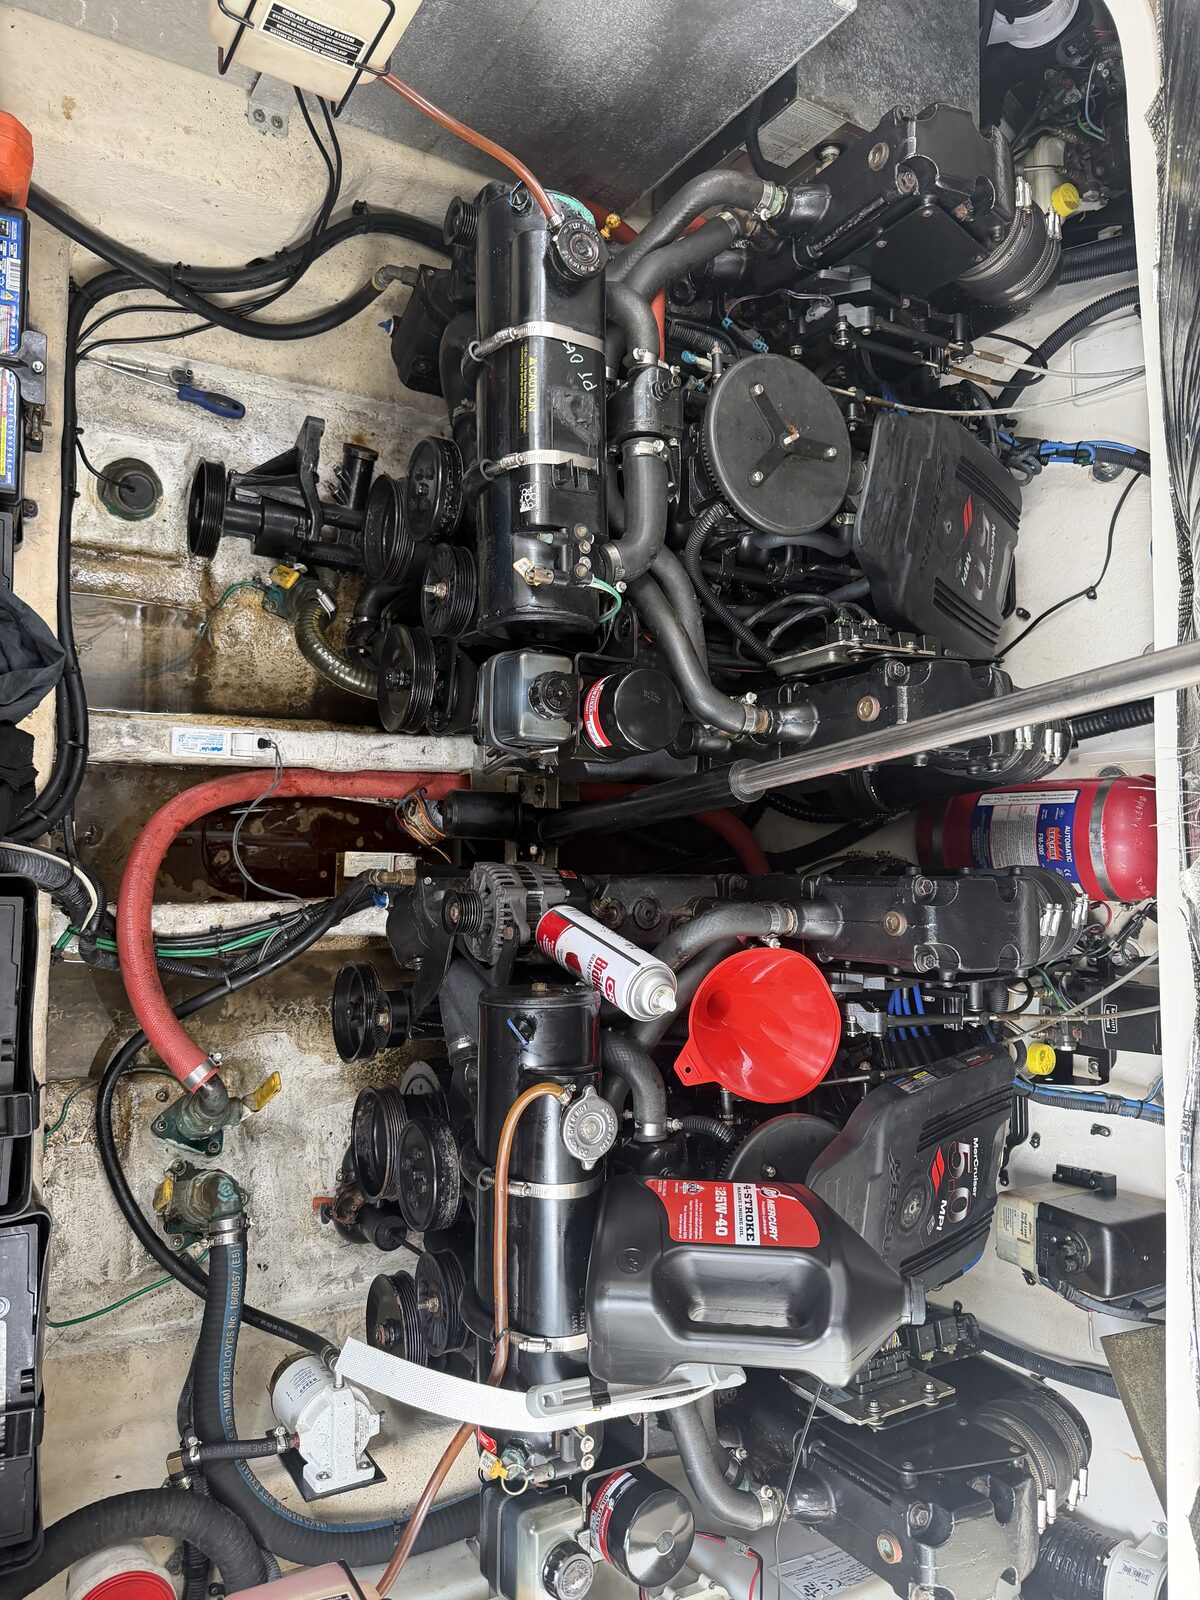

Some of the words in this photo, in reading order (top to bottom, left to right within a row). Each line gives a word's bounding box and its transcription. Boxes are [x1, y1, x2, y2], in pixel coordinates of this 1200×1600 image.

[281, 9, 307, 24] COOLANT
[306, 20, 335, 35] RECOVERY
[334, 32, 355, 44] SYSTEM
[529, 367, 537, 412] CAUTION
[960, 551, 972, 588] MPI
[987, 523, 995, 589] MerCruiser
[1064, 826, 1072, 862] AUTOMATIC
[587, 953, 596, 969] BRAKE
[947, 1141, 972, 1223] 5.0
[715, 1190, 728, 1236] 25W-40
[744, 1185, 755, 1241] 4-STROKE
[766, 1199, 778, 1242] MERCURY
[936, 1200, 948, 1231] MPI
[230, 1249, 241, 1267] (E5)
[228, 1271, 241, 1309] 16/80057
[226, 1313, 237, 1328] No.
[221, 1331, 235, 1369] LLOYDS
[221, 1371, 231, 1387] 926
[259, 1489, 275, 1505] WET
[275, 1502, 304, 1522] MARINE
